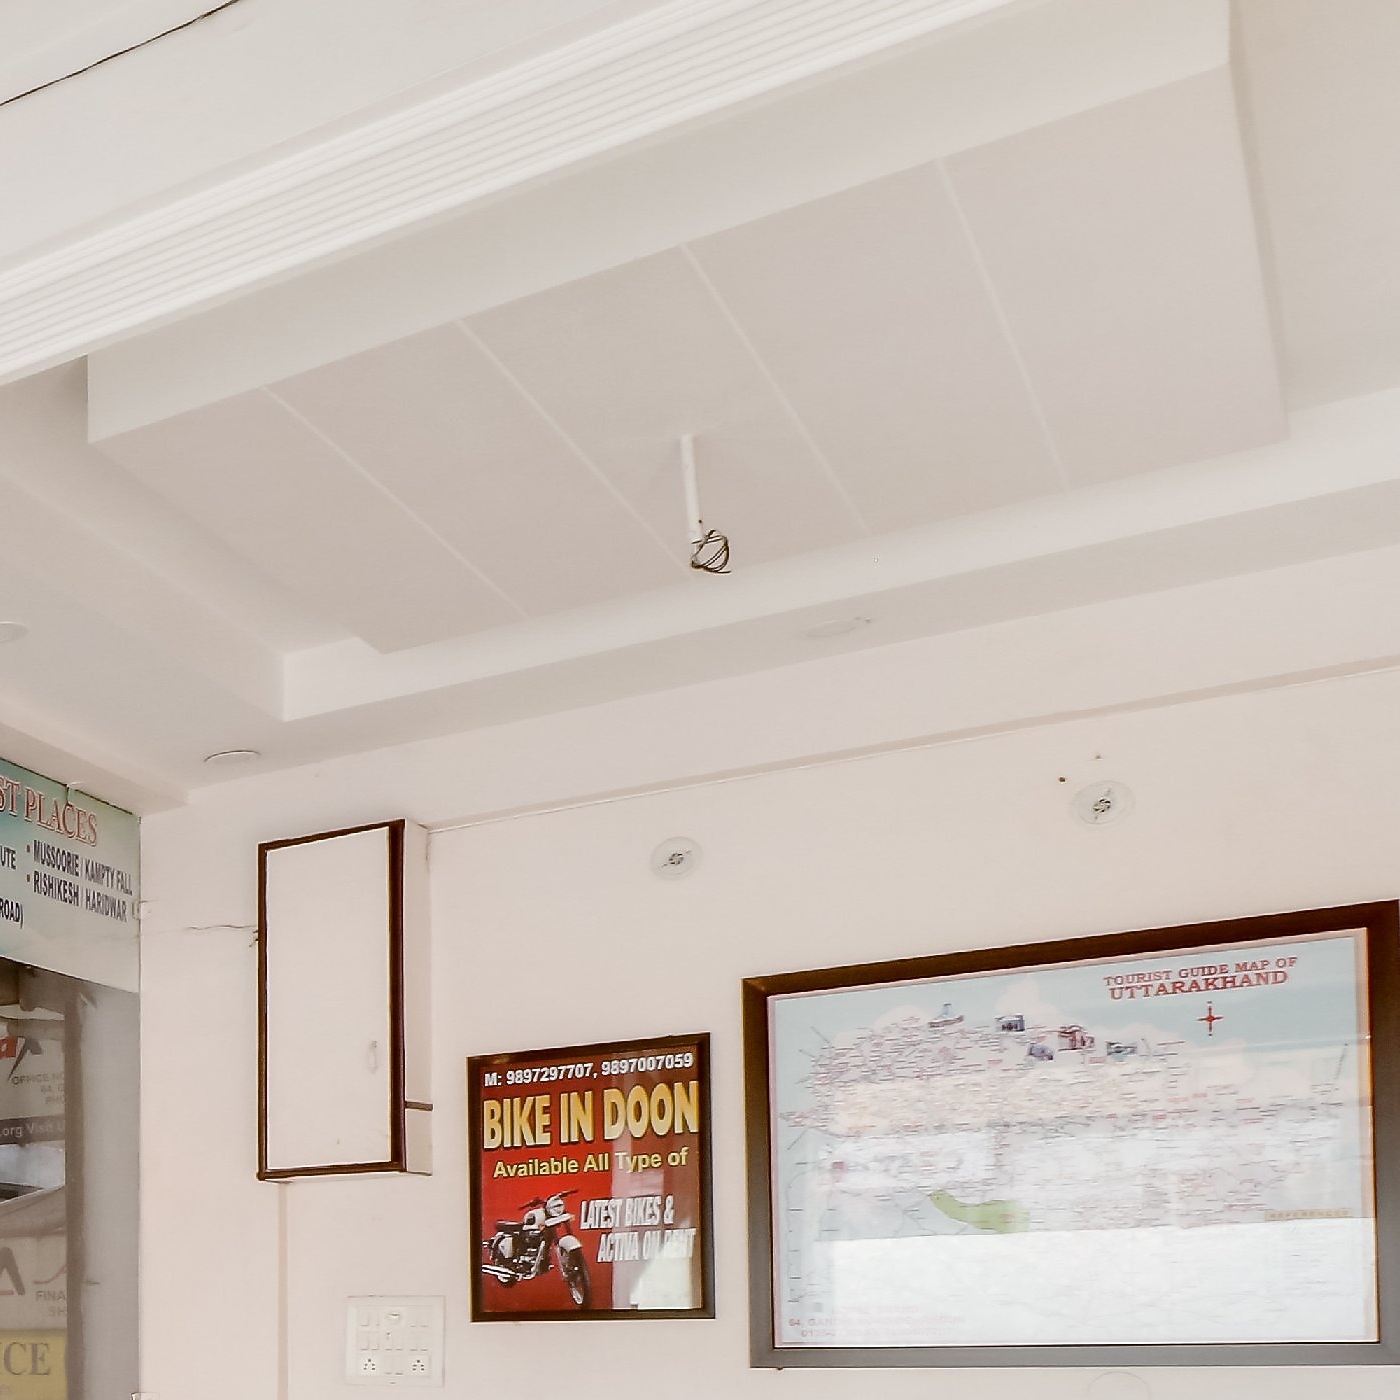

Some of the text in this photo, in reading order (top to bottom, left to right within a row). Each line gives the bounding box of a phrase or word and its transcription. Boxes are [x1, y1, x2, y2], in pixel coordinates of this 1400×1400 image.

[23, 786, 97, 847] PLACES
[33, 840, 79, 877] MUSSOORIE
[33, 870, 79, 907] RISHIKESH
[85, 888, 128, 923] HARIDWAR
[1104, 956, 1298, 986] TOURIST GUIDE MAP OF
[1108, 970, 1288, 1000] UTTARAKHAND
[484, 1072, 502, 1087] M:
[601, 1052, 694, 1076] 9897007059
[483, 1080, 700, 1149] BIKE IN DOON
[493, 1147, 689, 1179] Available All Type of
[580, 1195, 675, 1230] LATEST BIKES &
[597, 1231, 639, 1263] ACTIVA
